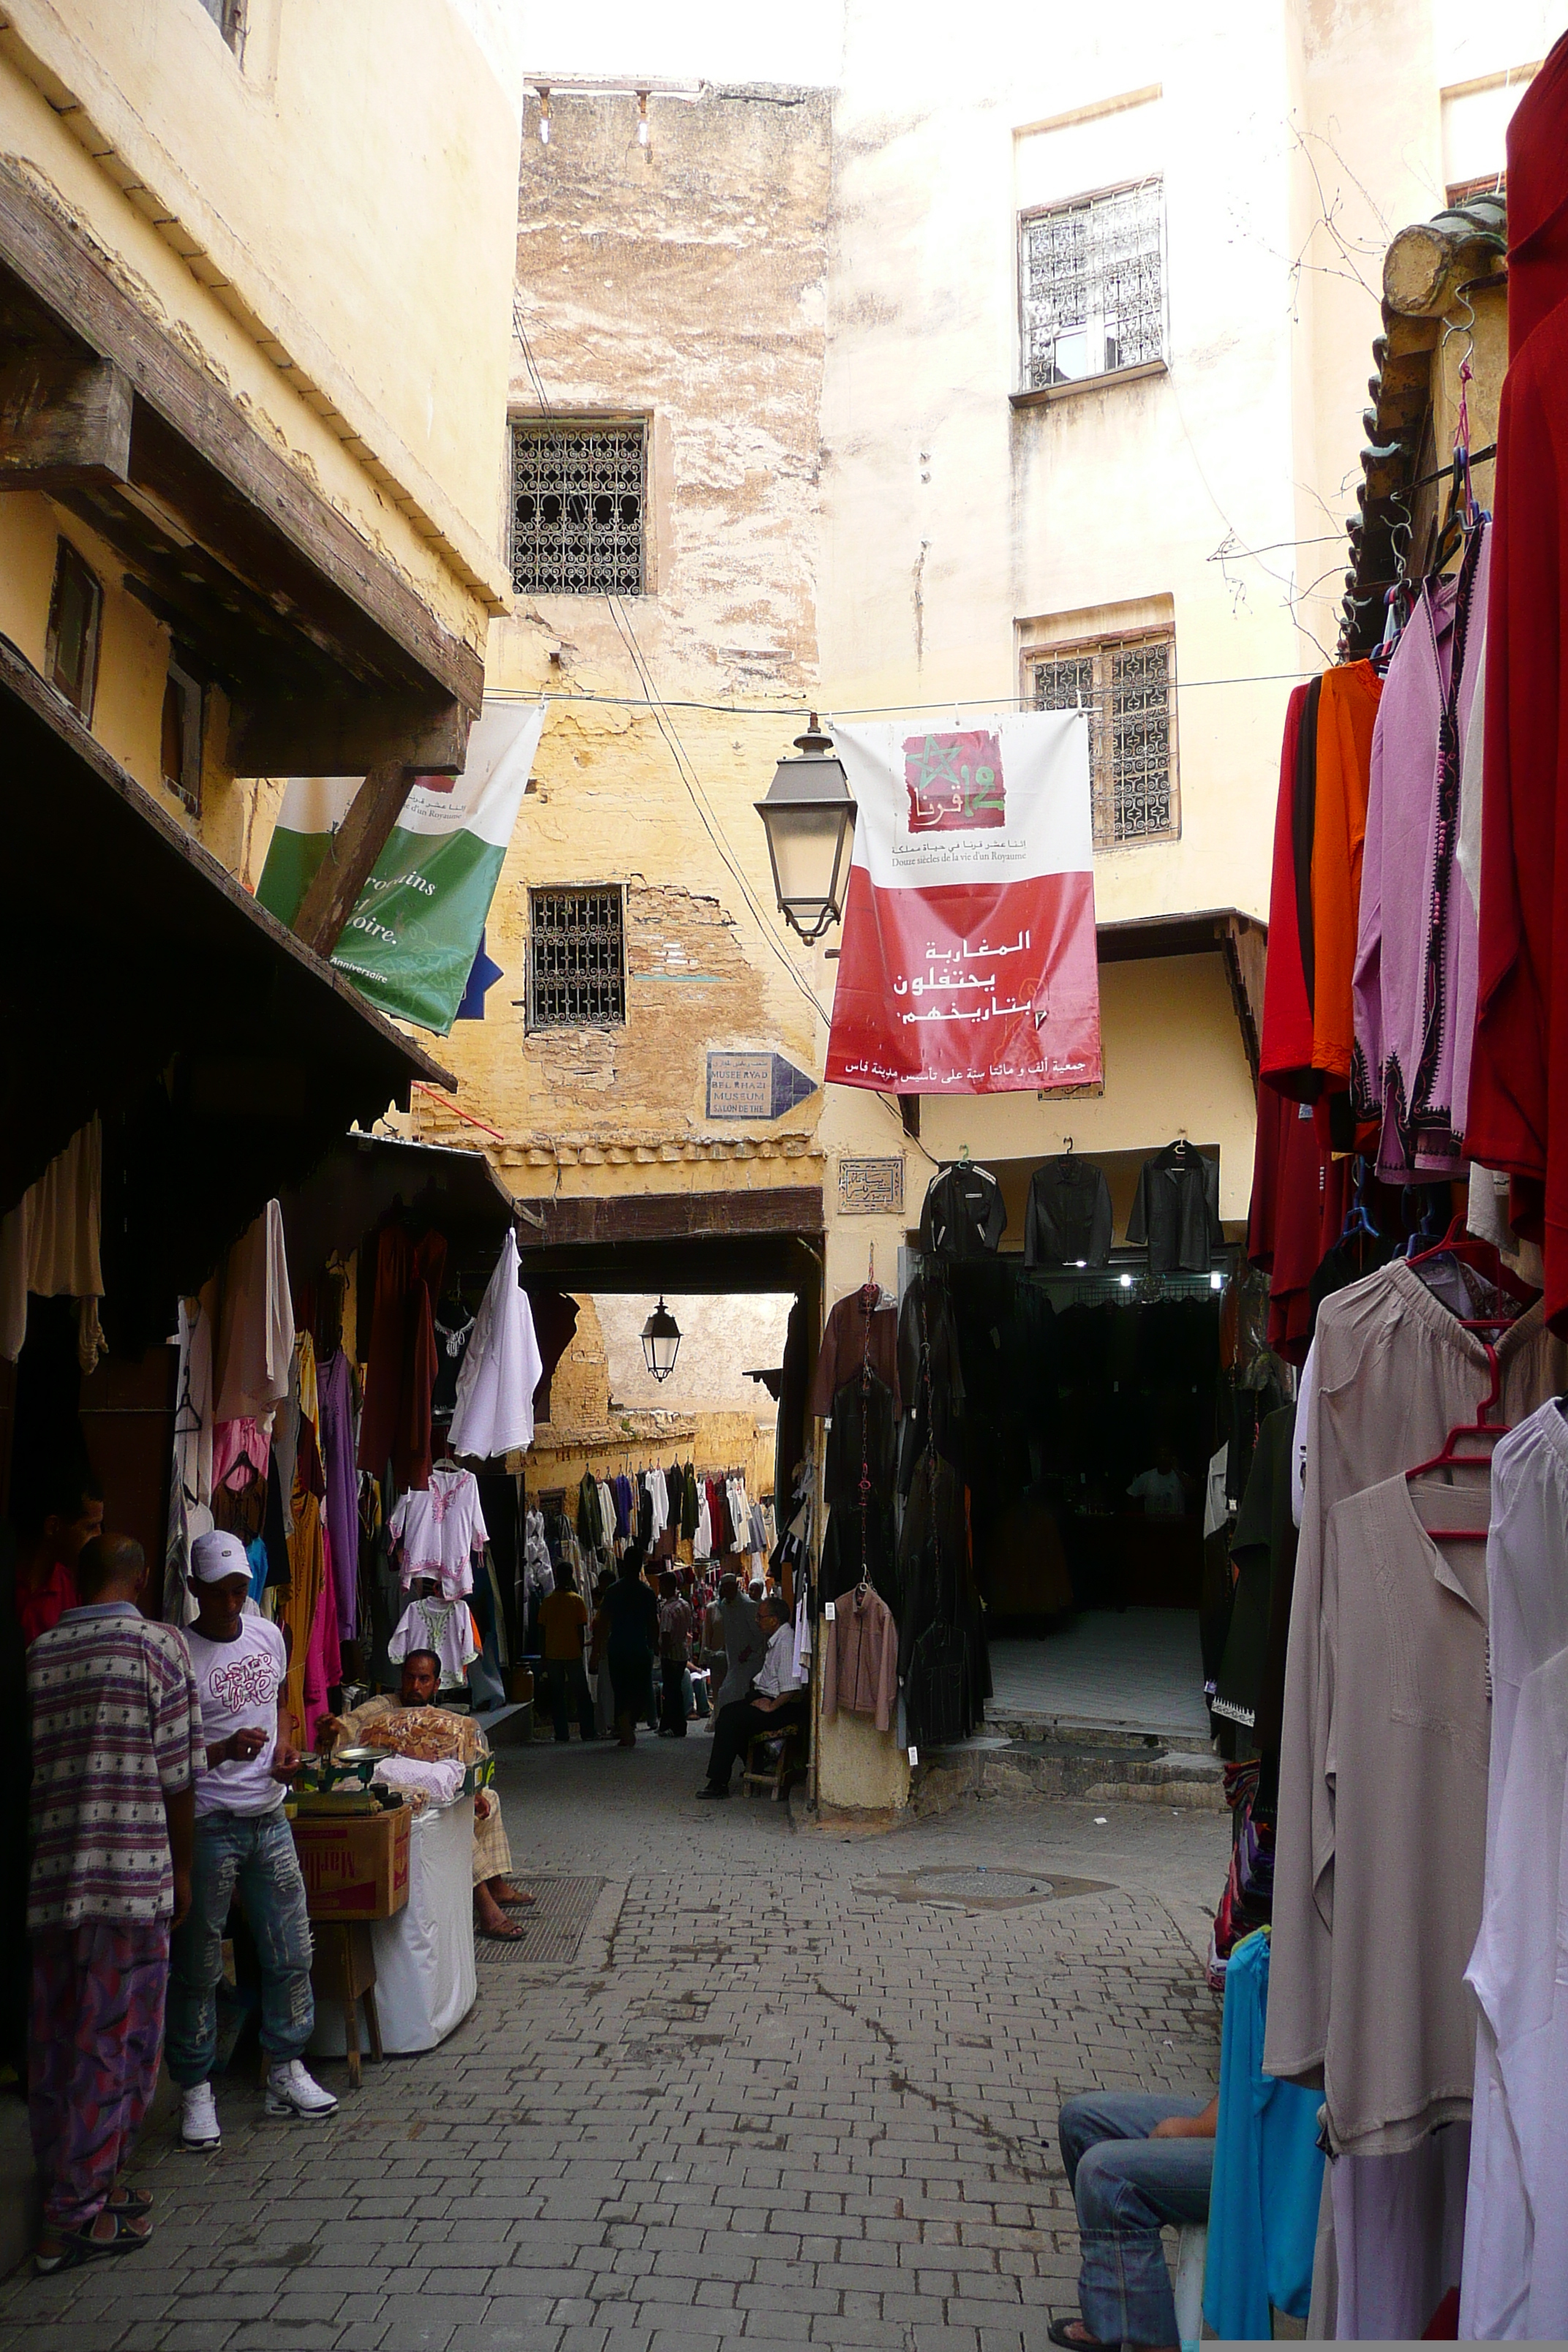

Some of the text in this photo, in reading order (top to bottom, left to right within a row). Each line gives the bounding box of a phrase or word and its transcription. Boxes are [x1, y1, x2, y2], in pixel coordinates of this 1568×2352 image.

[913, 785, 963, 826] قرنا
[892, 844, 921, 854] مملكة
[922, 843, 946, 852] حياة
[948, 843, 960, 853] في
[892, 851, 1027, 867] Douze siècles de la vie d'un Royaume
[925, 930, 1030, 963] المغاربة
[330, 957, 388, 984] Anniversaire
[893, 966, 995, 996] يحتفلون
[845, 1059, 868, 1073] فاس
[870, 1062, 898, 1079] مدينة
[1028, 1056, 1048, 1073] ألف
[1052, 1060, 1085, 1073] جمعية
[712, 1071, 768, 1079] MUSEE RYAD
[900, 1066, 938, 1083] تأسيس
[941, 1068, 963, 1084] على
[966, 1068, 985, 1079] سنة
[1017, 1068, 1025, 1077] و
[712, 1081, 766, 1089] BEL RHAZI
[714, 1092, 764, 1101] MUSEUM
[713, 1104, 764, 1113] SALON DE THE
